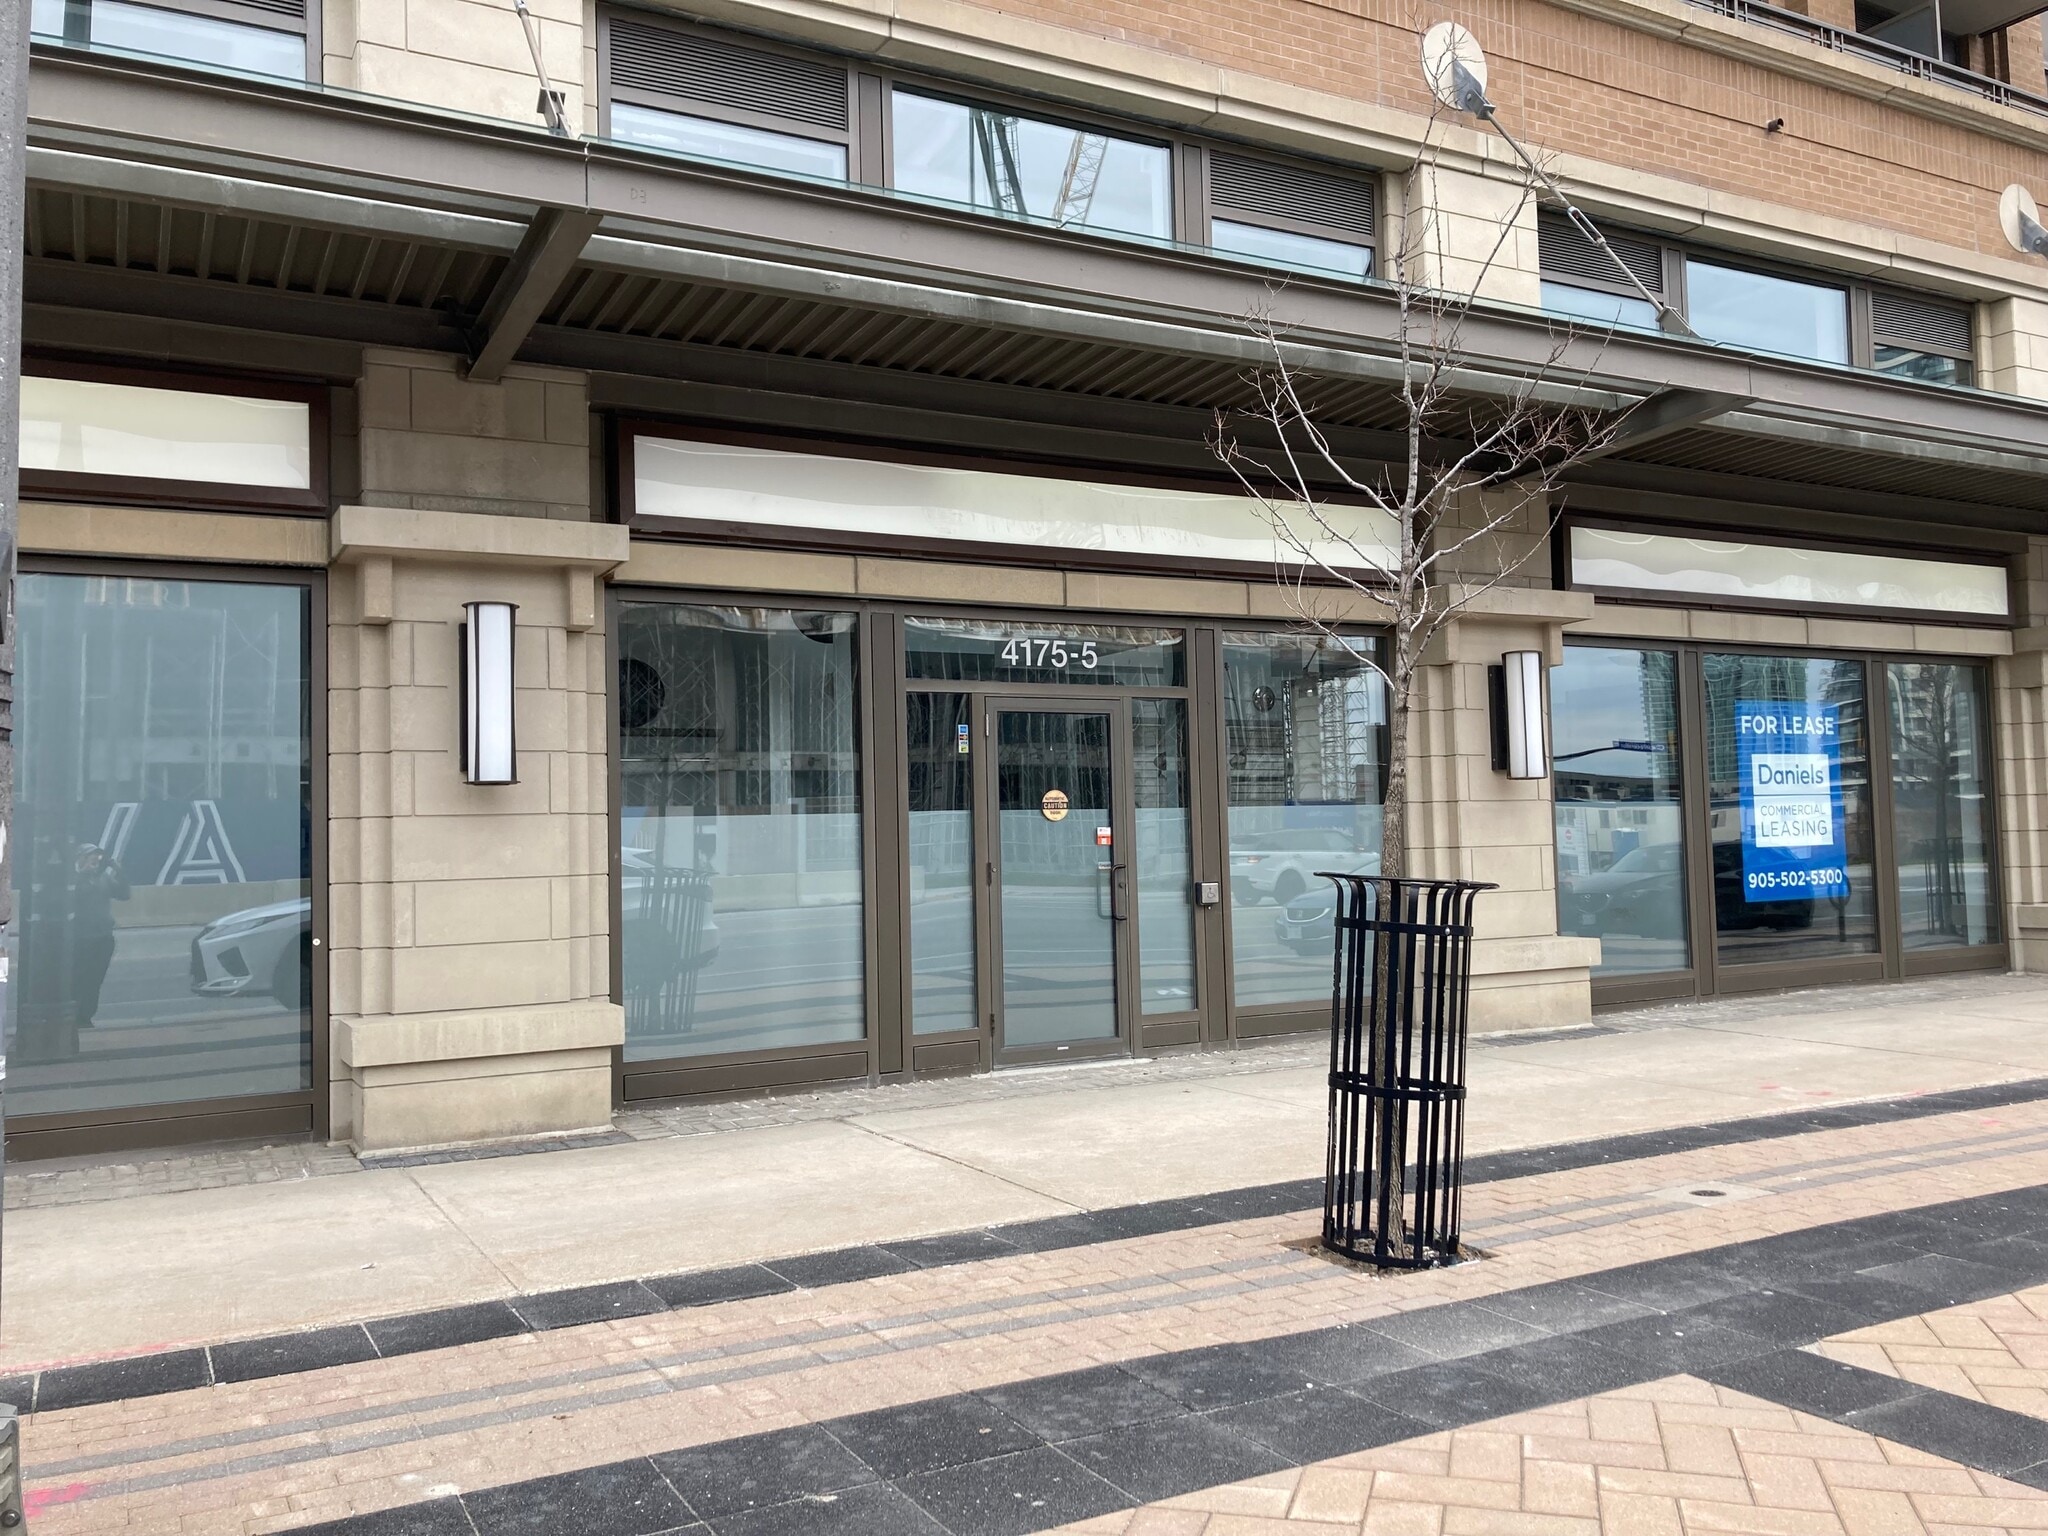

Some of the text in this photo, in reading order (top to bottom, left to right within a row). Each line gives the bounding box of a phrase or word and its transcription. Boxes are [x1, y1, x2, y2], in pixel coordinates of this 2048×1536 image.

[1001, 638, 1098, 669] 4175-5
[1741, 715, 1835, 736] FOR LEASE
[1758, 763, 1824, 785] Daniels
[1760, 804, 1826, 816] COMMERCIAL
[1761, 820, 1828, 837] LEASING
[1748, 868, 1843, 889] 905-502-5300
